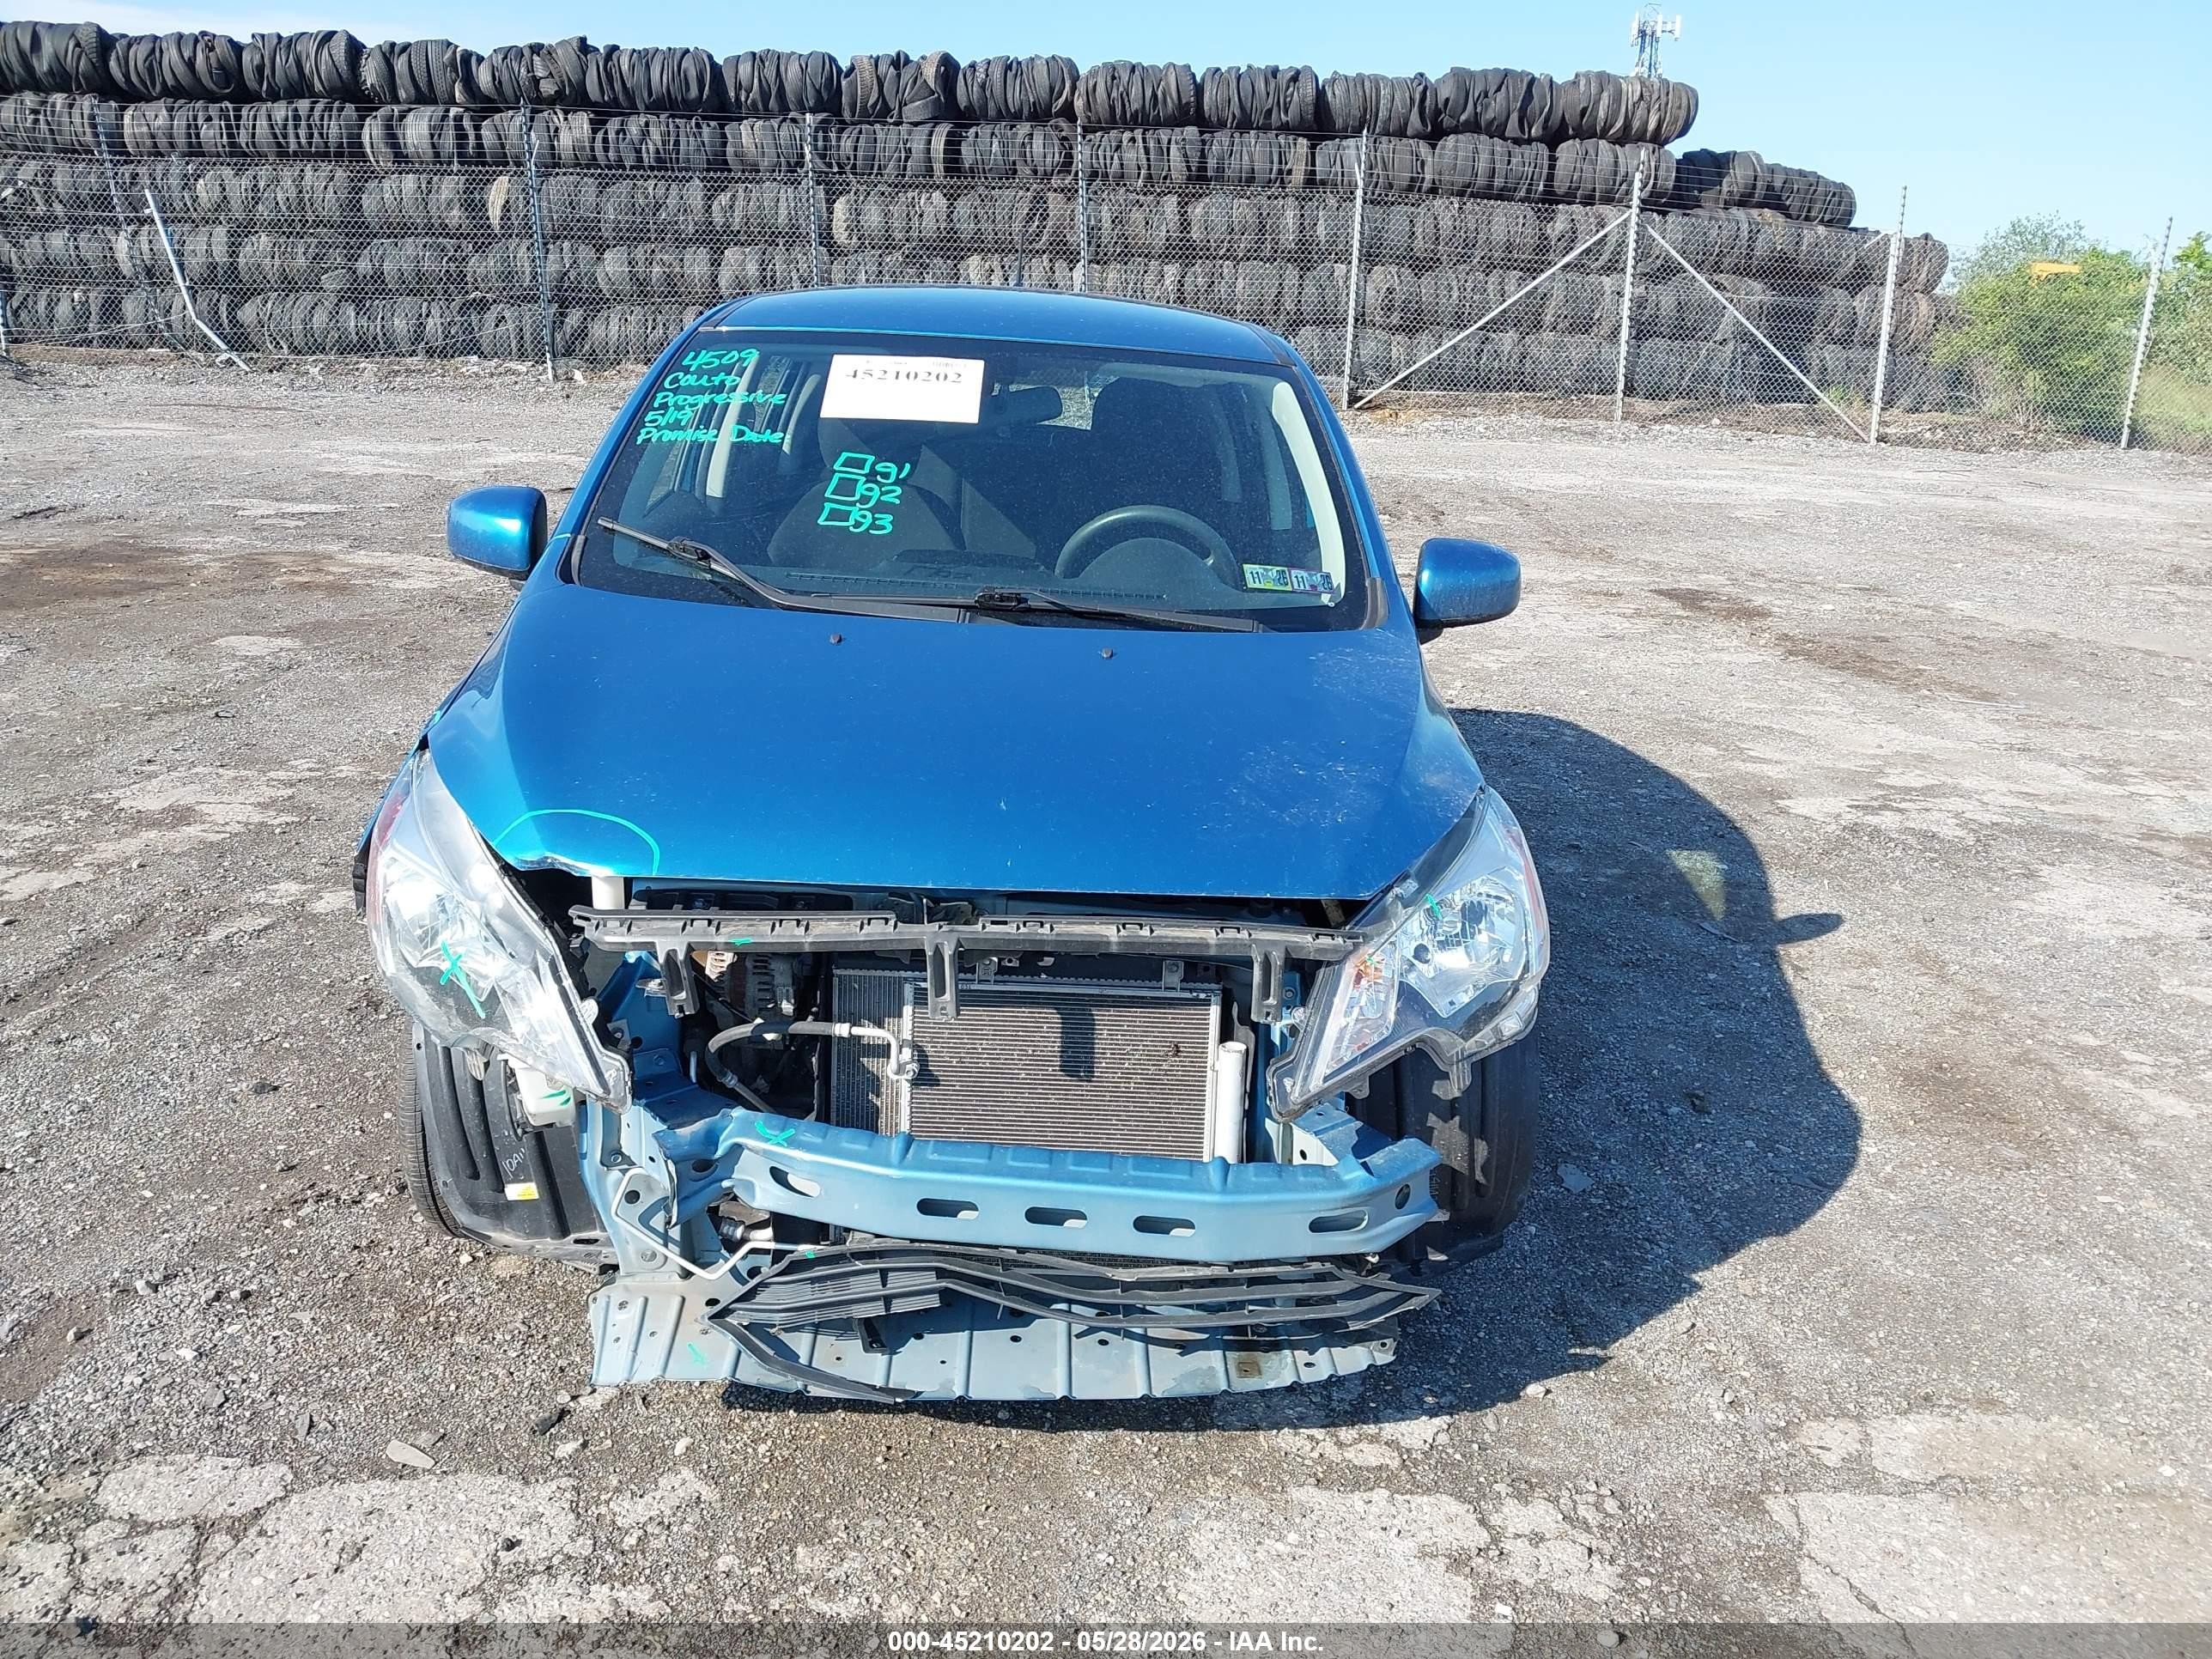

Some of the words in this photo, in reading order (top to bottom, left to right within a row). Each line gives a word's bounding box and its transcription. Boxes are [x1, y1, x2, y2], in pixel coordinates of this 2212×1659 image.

[682, 348, 760, 371] 4509
[846, 368, 963, 383] 45210202
[653, 389, 787, 410] Progressive
[644, 407, 693, 427] 5/19
[635, 426, 720, 445] Promise
[730, 424, 785, 443] Date
[856, 483, 902, 508] 92
[849, 510, 893, 534] 93
